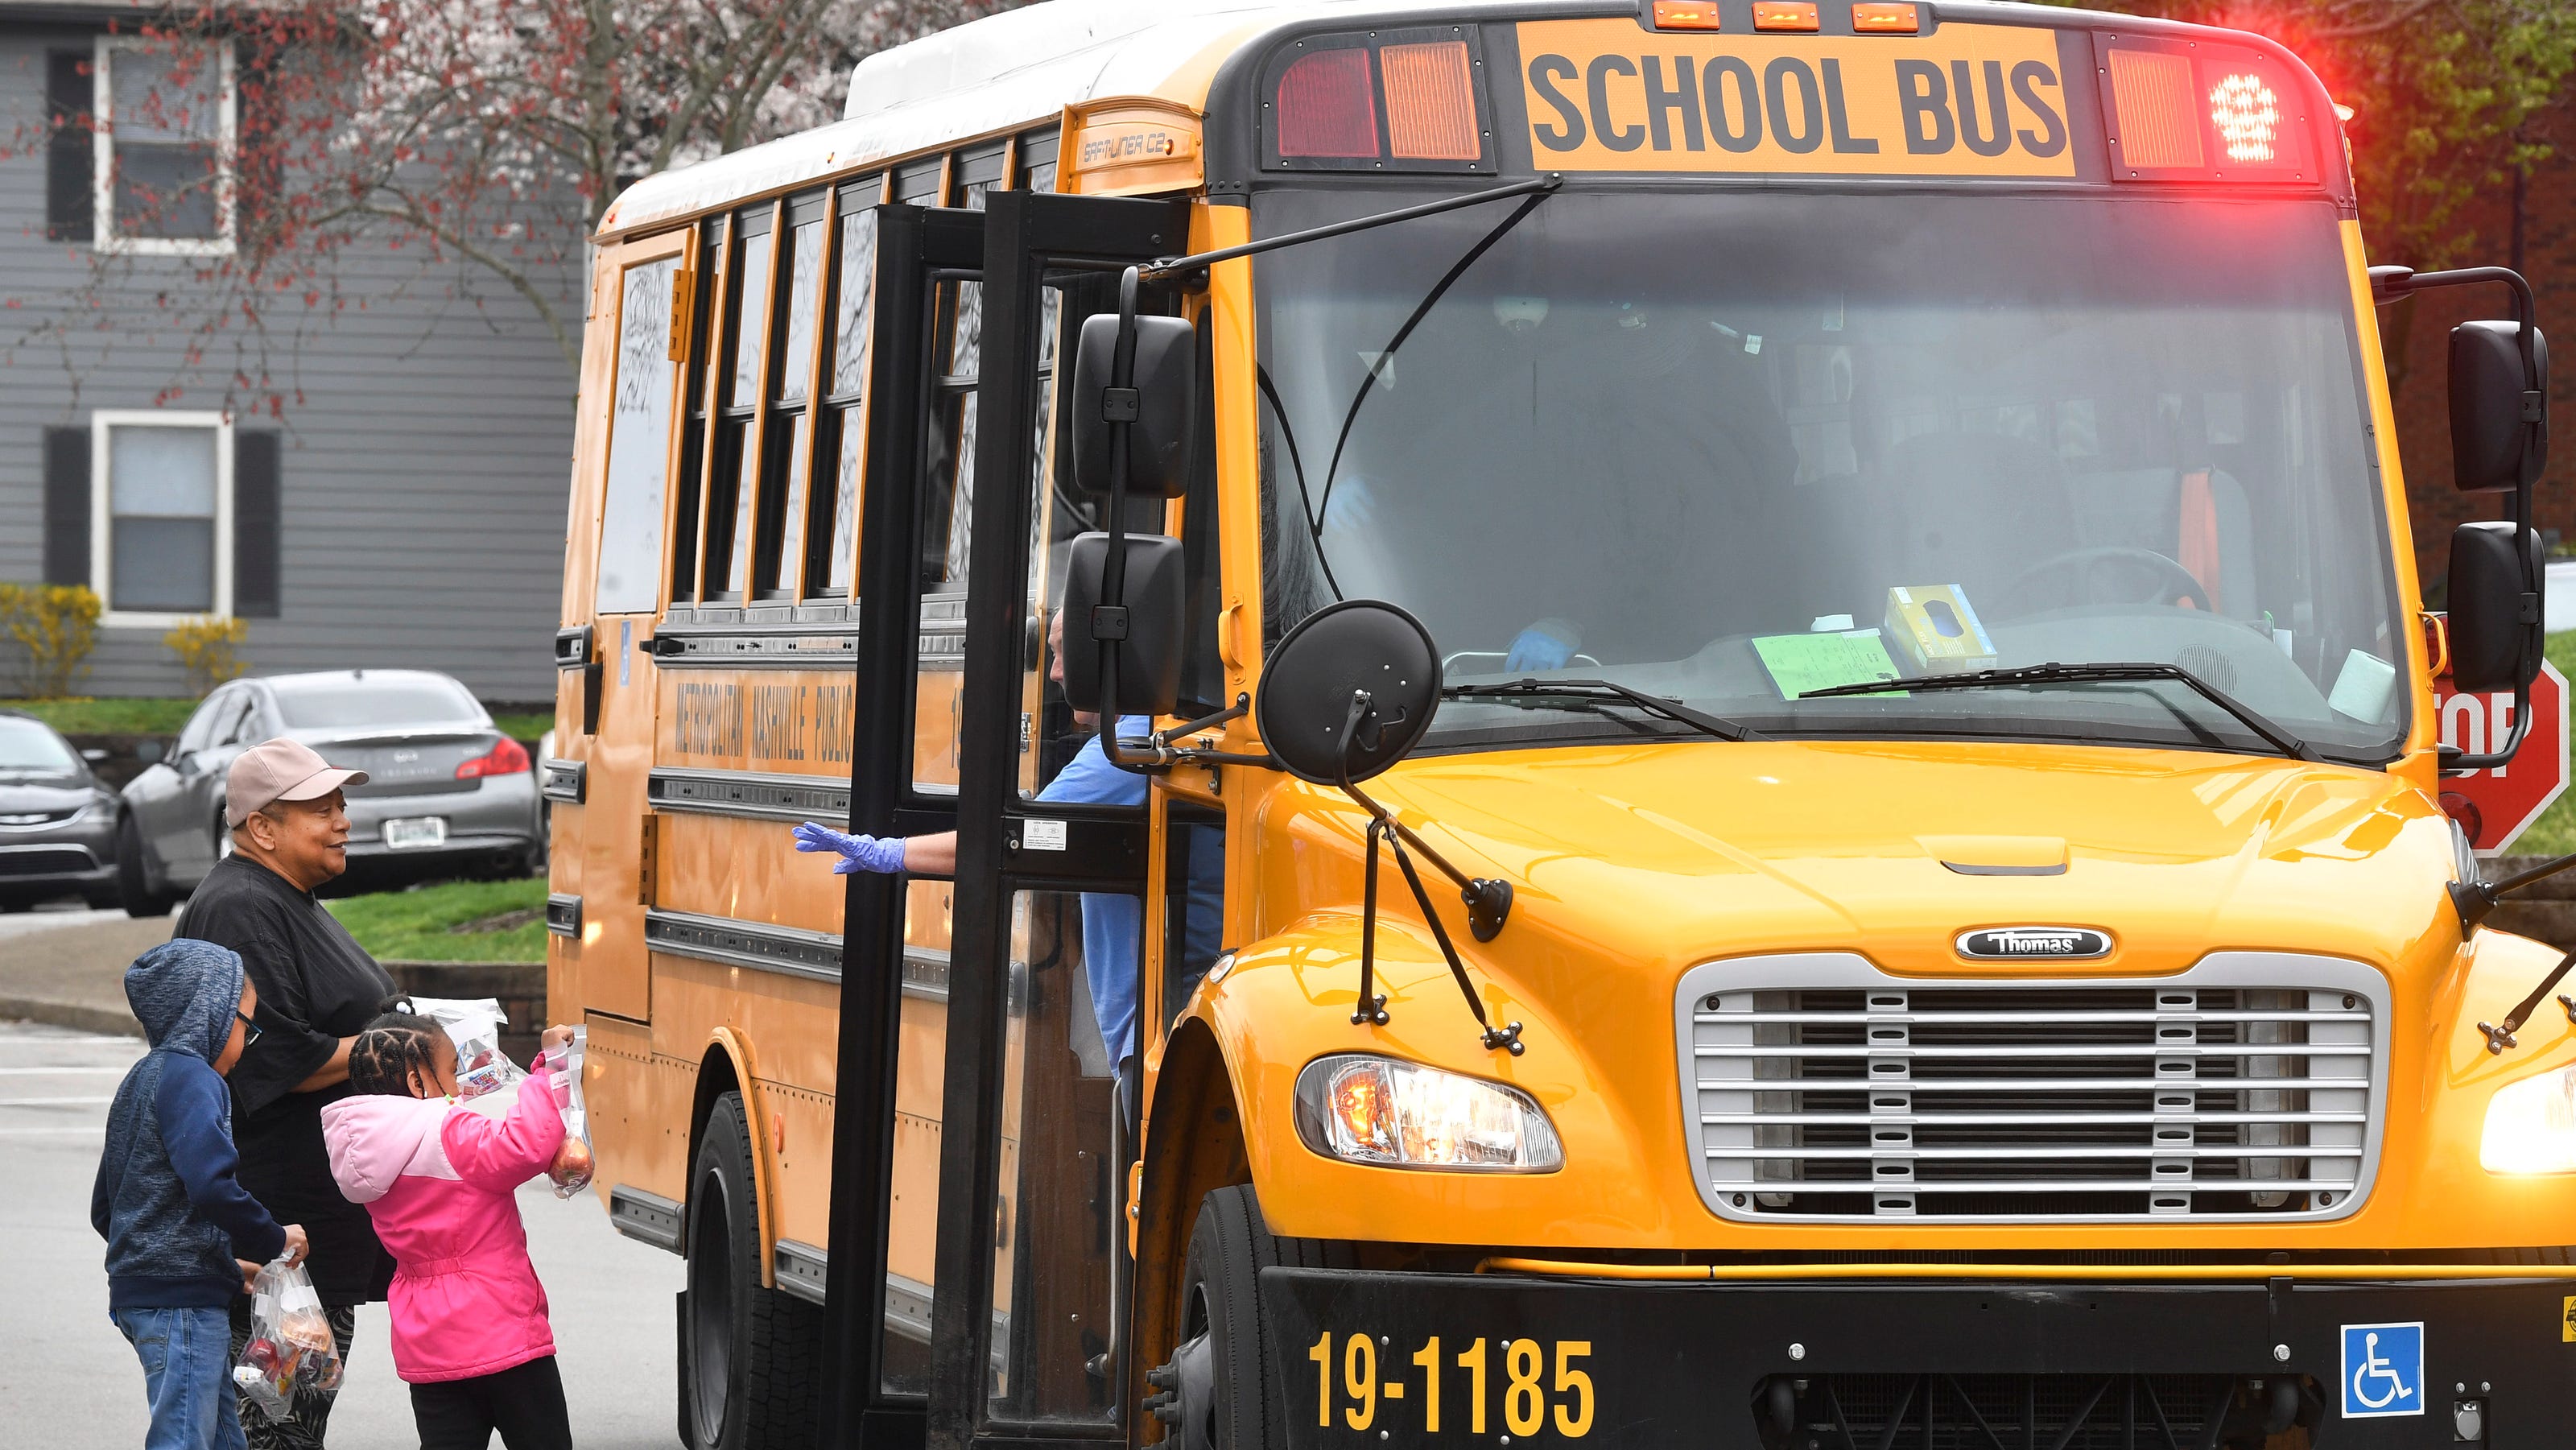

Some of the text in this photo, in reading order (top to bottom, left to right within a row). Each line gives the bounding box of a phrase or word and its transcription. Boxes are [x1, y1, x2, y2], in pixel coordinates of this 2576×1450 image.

[1146, 133, 1165, 153] C2
[1529, 54, 2067, 158] SCHOOL BUS
[675, 683, 852, 763] METROPOLITAN NASHVILLE PUBLIC
[1987, 932, 2083, 953] Thomas
[1309, 1331, 1595, 1438] 19-1185
